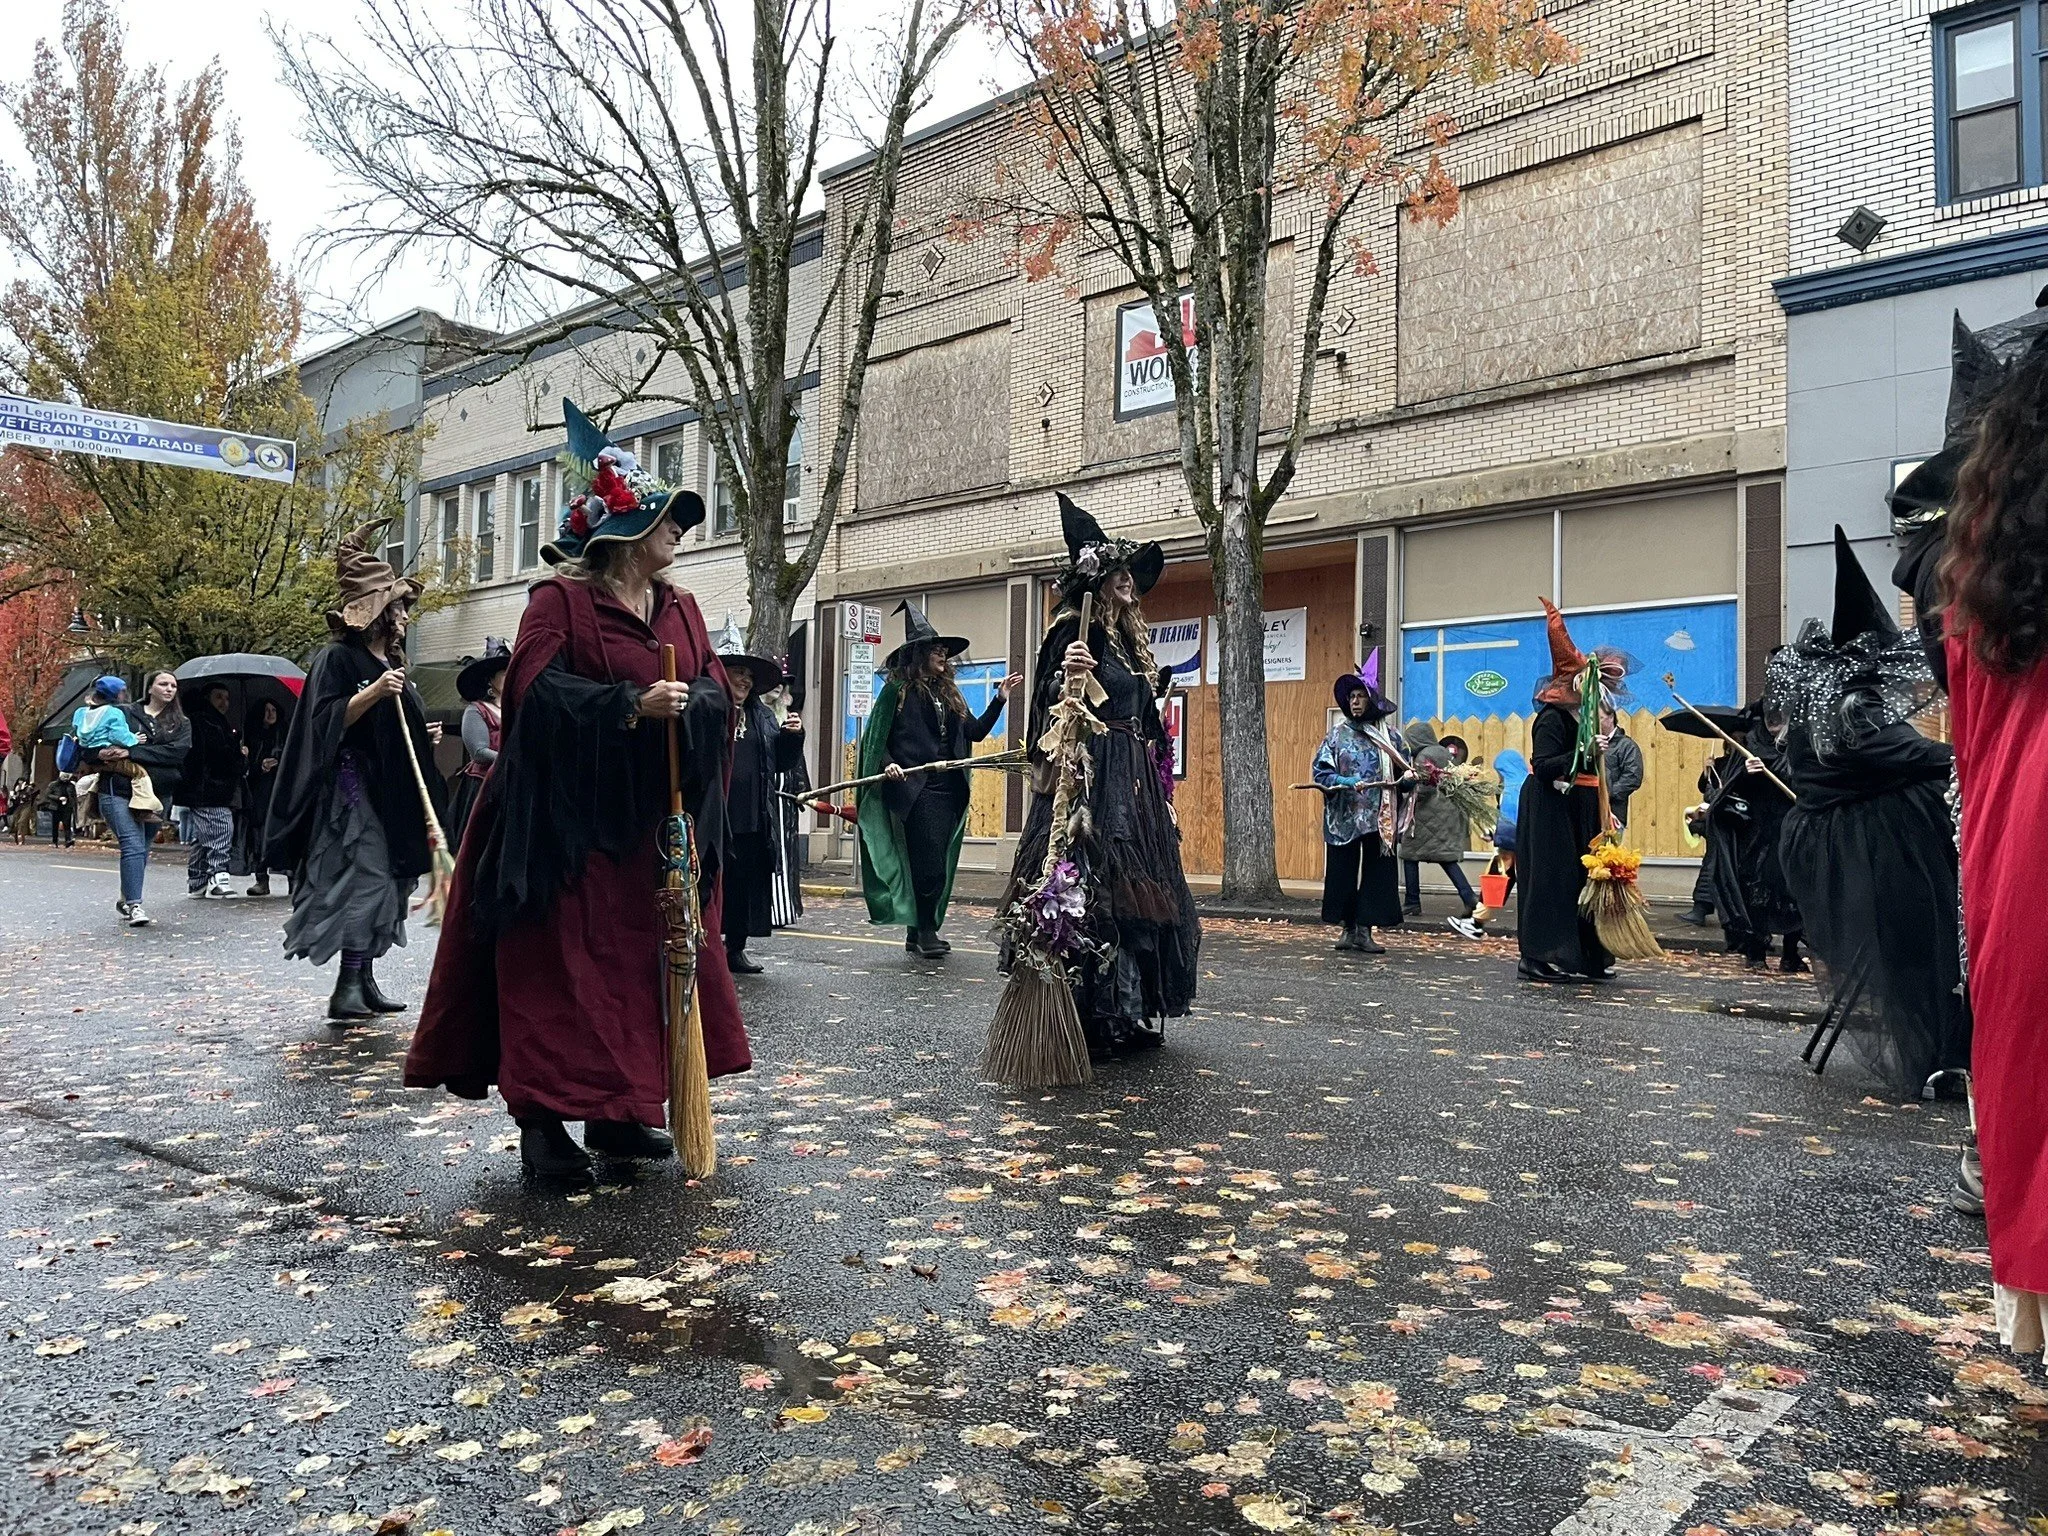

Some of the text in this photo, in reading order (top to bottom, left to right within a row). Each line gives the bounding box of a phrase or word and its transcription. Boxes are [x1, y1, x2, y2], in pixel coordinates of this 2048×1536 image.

[1130, 354, 1172, 386] WO
[1124, 381, 1169, 398] CONSTRUCTION
[25, 404, 78, 422] Legion
[83, 415, 118, 429] Post
[122, 421, 139, 432] 21
[0, 415, 204, 454] VETERAN'S DAY PARADE
[38, 436, 46, 444] 9
[71, 440, 102, 452] 10:00
[104, 445, 122, 454] am
[866, 620, 879, 628] FREE
[1159, 623, 1200, 643] HEATING
[1264, 656, 1292, 665] ESIGNERS
